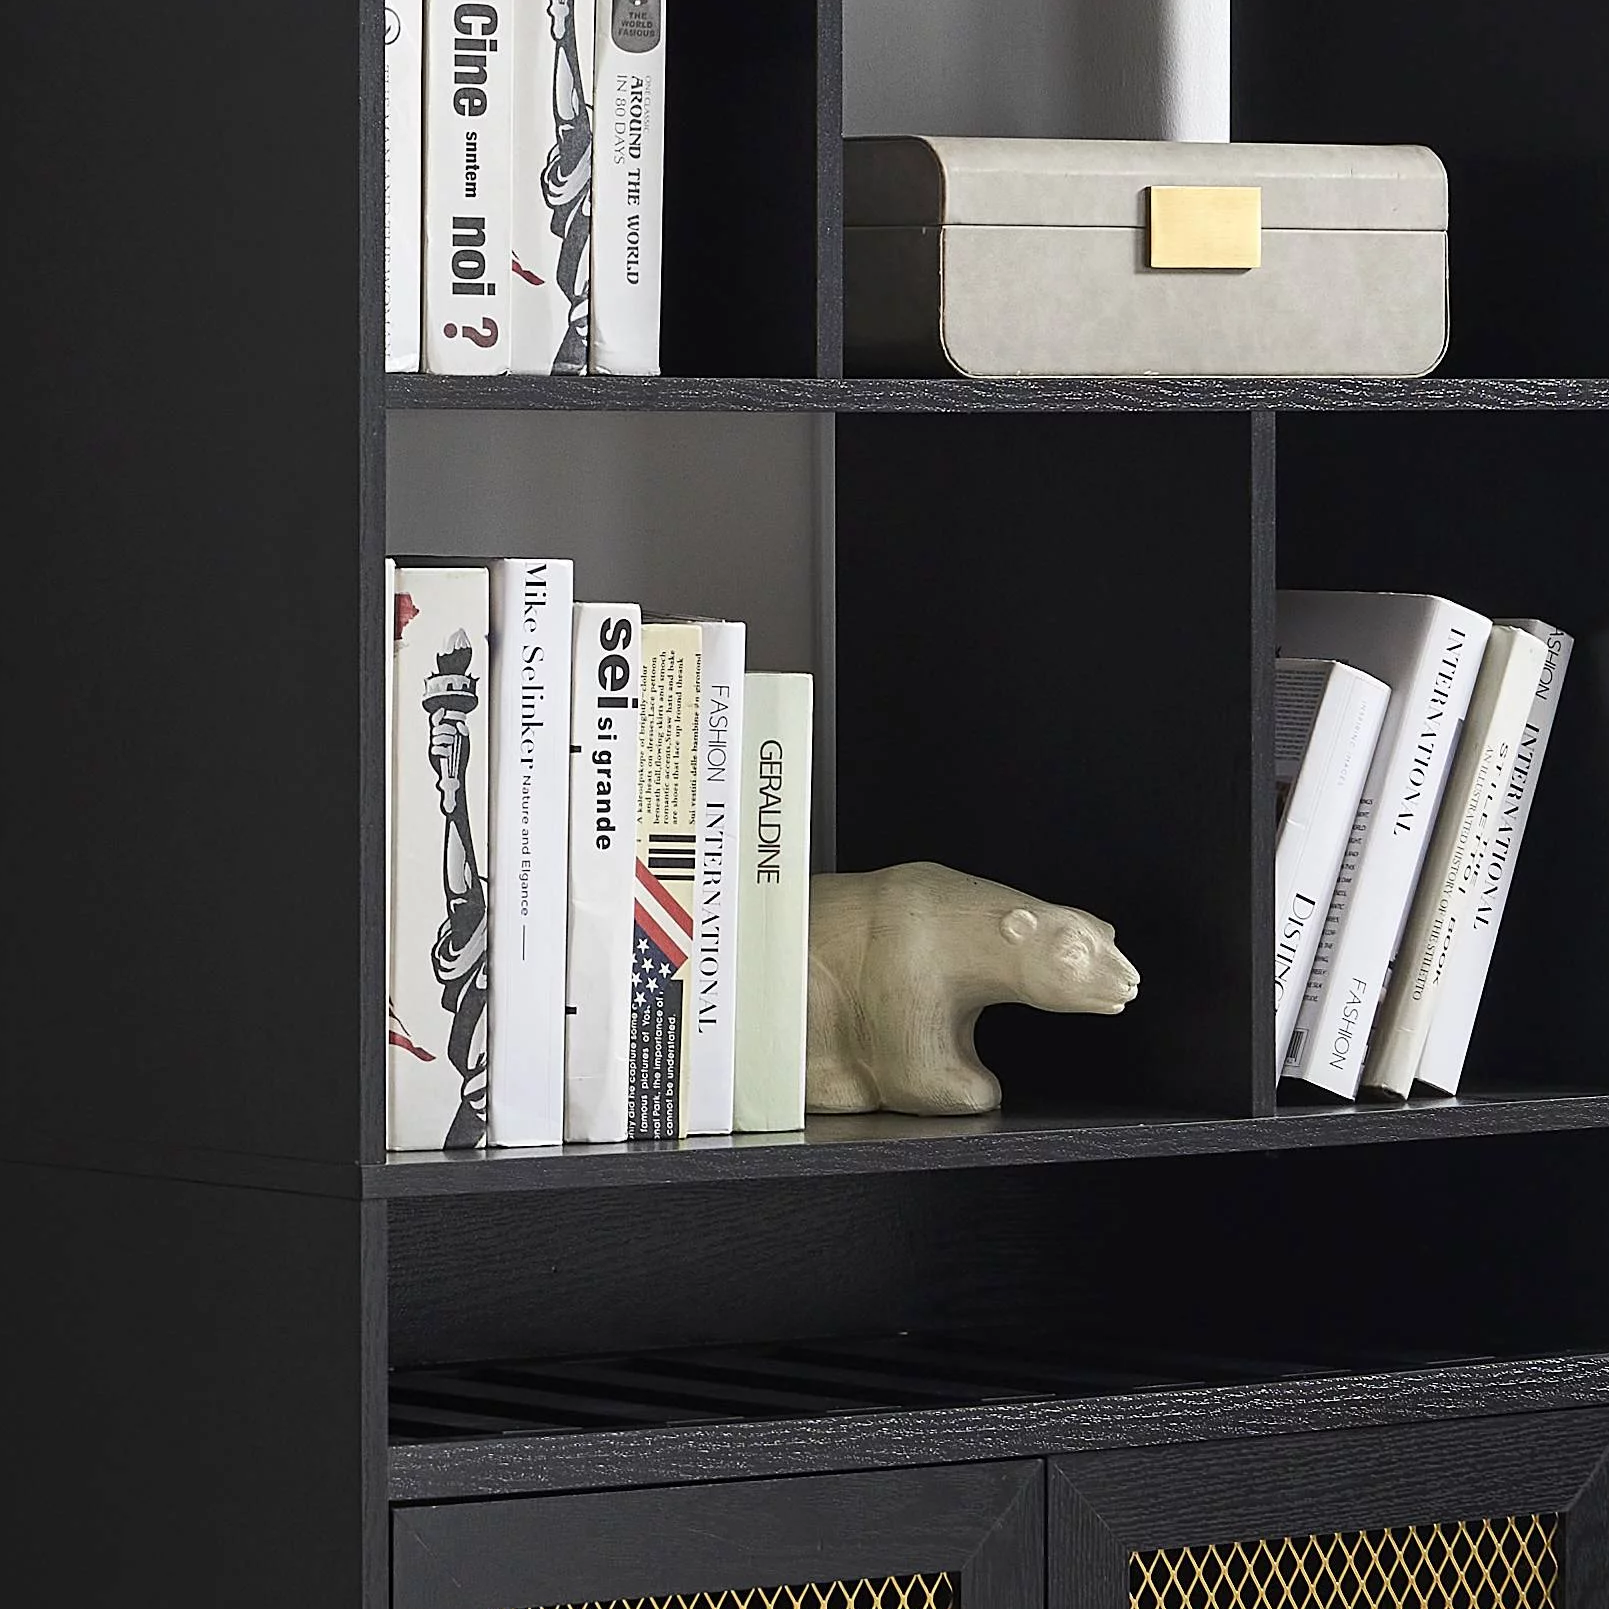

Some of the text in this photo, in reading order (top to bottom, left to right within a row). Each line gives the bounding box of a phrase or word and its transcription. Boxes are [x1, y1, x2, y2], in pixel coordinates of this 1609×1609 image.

[453, 3, 498, 117] Cine
[614, 75, 627, 164] IN 80 DAYS
[627, 76, 644, 285] AROUND THE WORLD
[452, 216, 495, 296] noi
[444, 317, 498, 348] ?
[520, 562, 547, 916] Mike Selinker Nature and Elgance
[593, 617, 639, 850] Sei si grande
[1393, 628, 1466, 835] INTERNATIONAL
[756, 739, 783, 884] GERALDINE
[1460, 765, 1488, 845] ILLUSTRATED
[1474, 723, 1540, 930] INTERNATIONAL
[698, 684, 730, 1033] FASHION INTERNATIONAL
[1443, 846, 1464, 899] HISTORY
[1431, 920, 1443, 942] THE
[1438, 899, 1448, 914] OF
[1412, 943, 1435, 1000] STILETTO
[1433, 917, 1455, 985] BOOK
[642, 1031, 650, 1042] of
[654, 1010, 663, 1069] importance
[1329, 978, 1366, 1070] FASHION
[641, 1048, 649, 1089] pictures
[665, 1082, 674, 1096] be
[640, 1095, 648, 1132] famous
[665, 1099, 674, 1136] cannot
